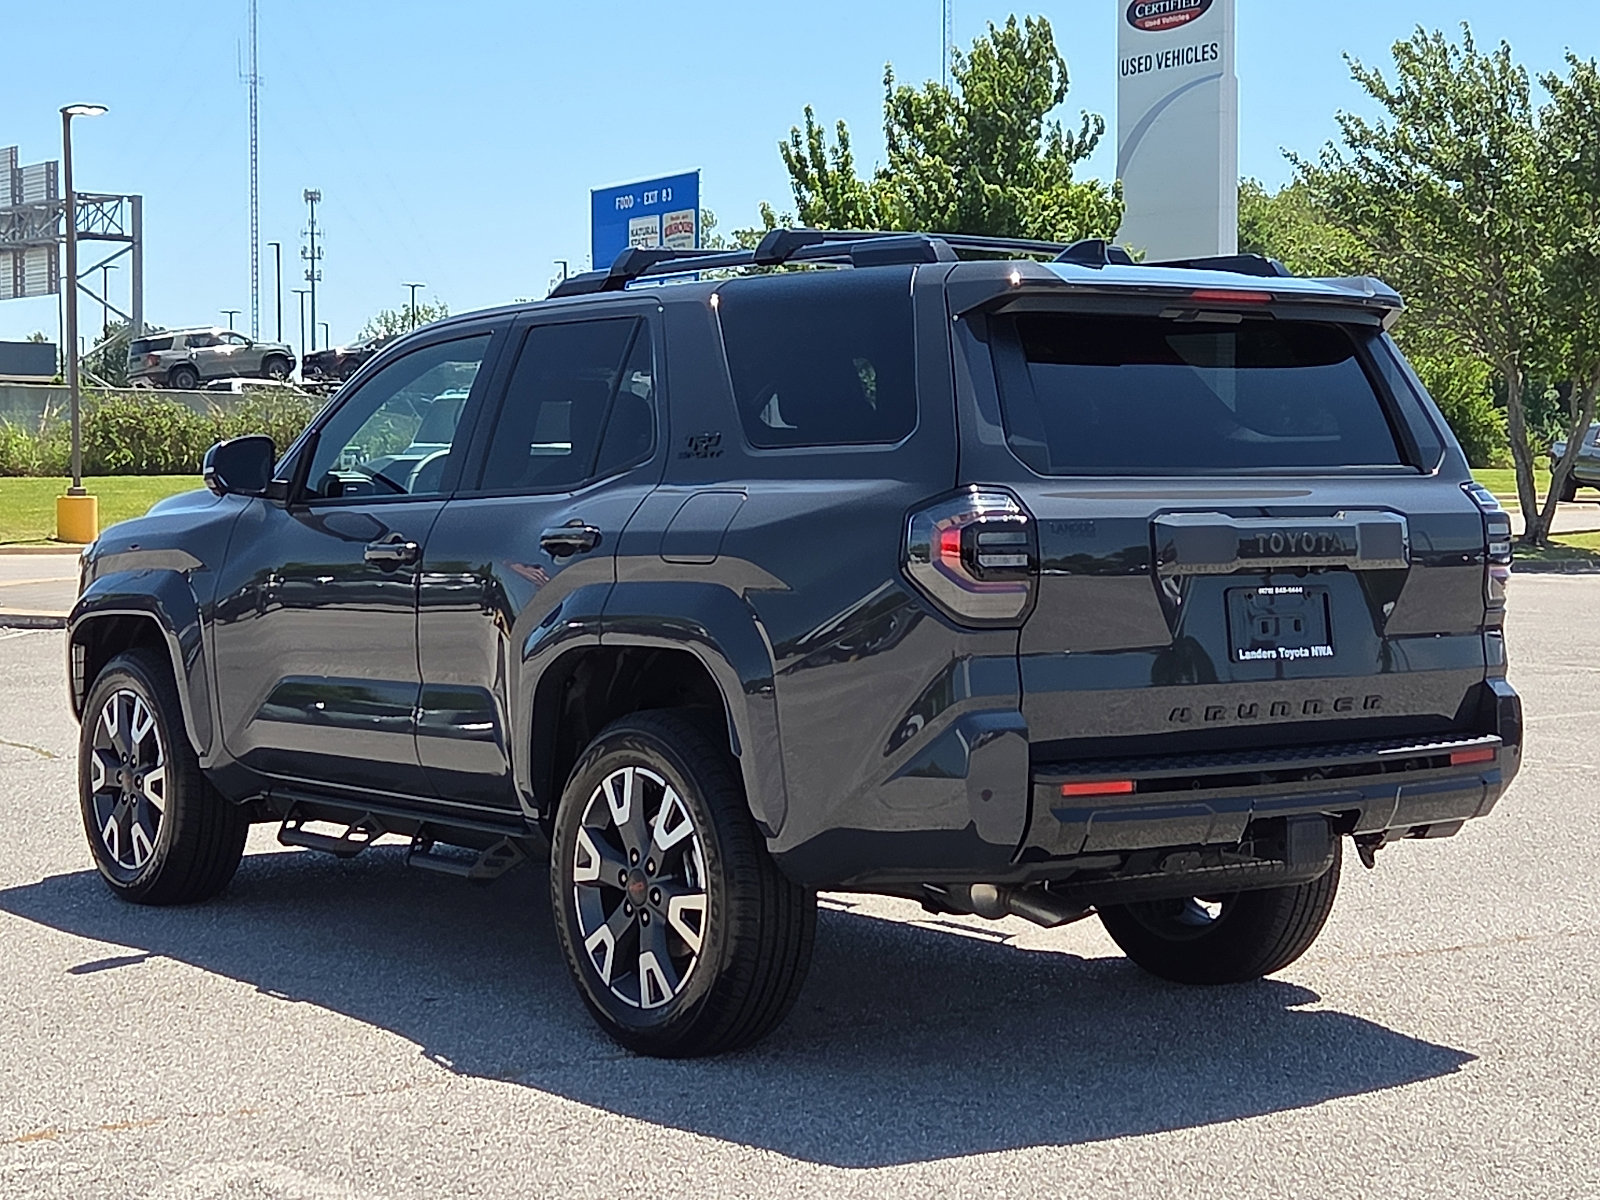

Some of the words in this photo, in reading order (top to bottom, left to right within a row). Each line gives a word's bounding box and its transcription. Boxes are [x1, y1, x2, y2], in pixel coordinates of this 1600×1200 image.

[1135, 0, 1200, 18] CERTIFIED
[1144, 17, 1161, 28] Used
[1161, 13, 1190, 25] Vehicles
[1121, 54, 1153, 77] USED
[1155, 42, 1219, 70] VEHICLES
[615, 194, 634, 210] FOOD
[643, 190, 658, 206] EXIT
[630, 225, 659, 238] NATURAL
[1255, 531, 1345, 554] TOYOTA
[1239, 648, 1277, 660] Landers
[1278, 646, 1310, 660] Toyota
[1310, 645, 1334, 657] NWA
[1168, 694, 1384, 723] 4RUNNER
